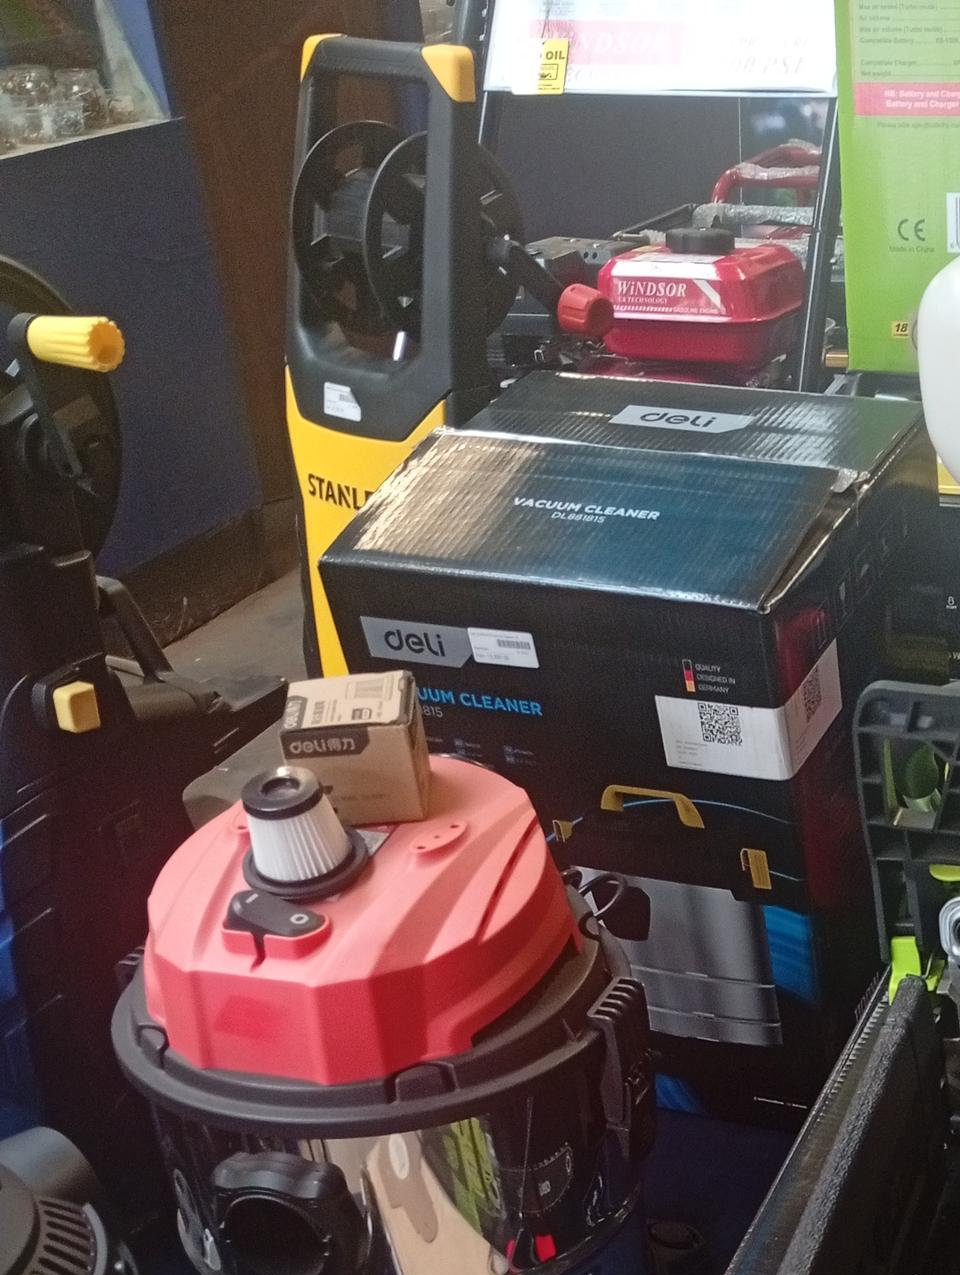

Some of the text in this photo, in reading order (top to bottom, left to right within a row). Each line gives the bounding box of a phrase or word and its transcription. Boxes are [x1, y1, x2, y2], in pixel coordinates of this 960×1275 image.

[545, 50, 566, 61] OIL
[899, 90, 924, 99] Battery
[926, 90, 938, 98] and
[886, 100, 912, 109] Battery
[914, 100, 928, 108] and
[929, 100, 959, 109] Charger
[639, 412, 717, 428] deli
[513, 497, 660, 521] VACUUM CLEANER
[384, 629, 446, 657] deli
[695, 663, 721, 673] QUALITY
[696, 674, 728, 684] DESIGNED
[698, 684, 730, 694] GERMANY
[418, 687, 543, 716] UUM CLEANER
[423, 706, 443, 718] 815
